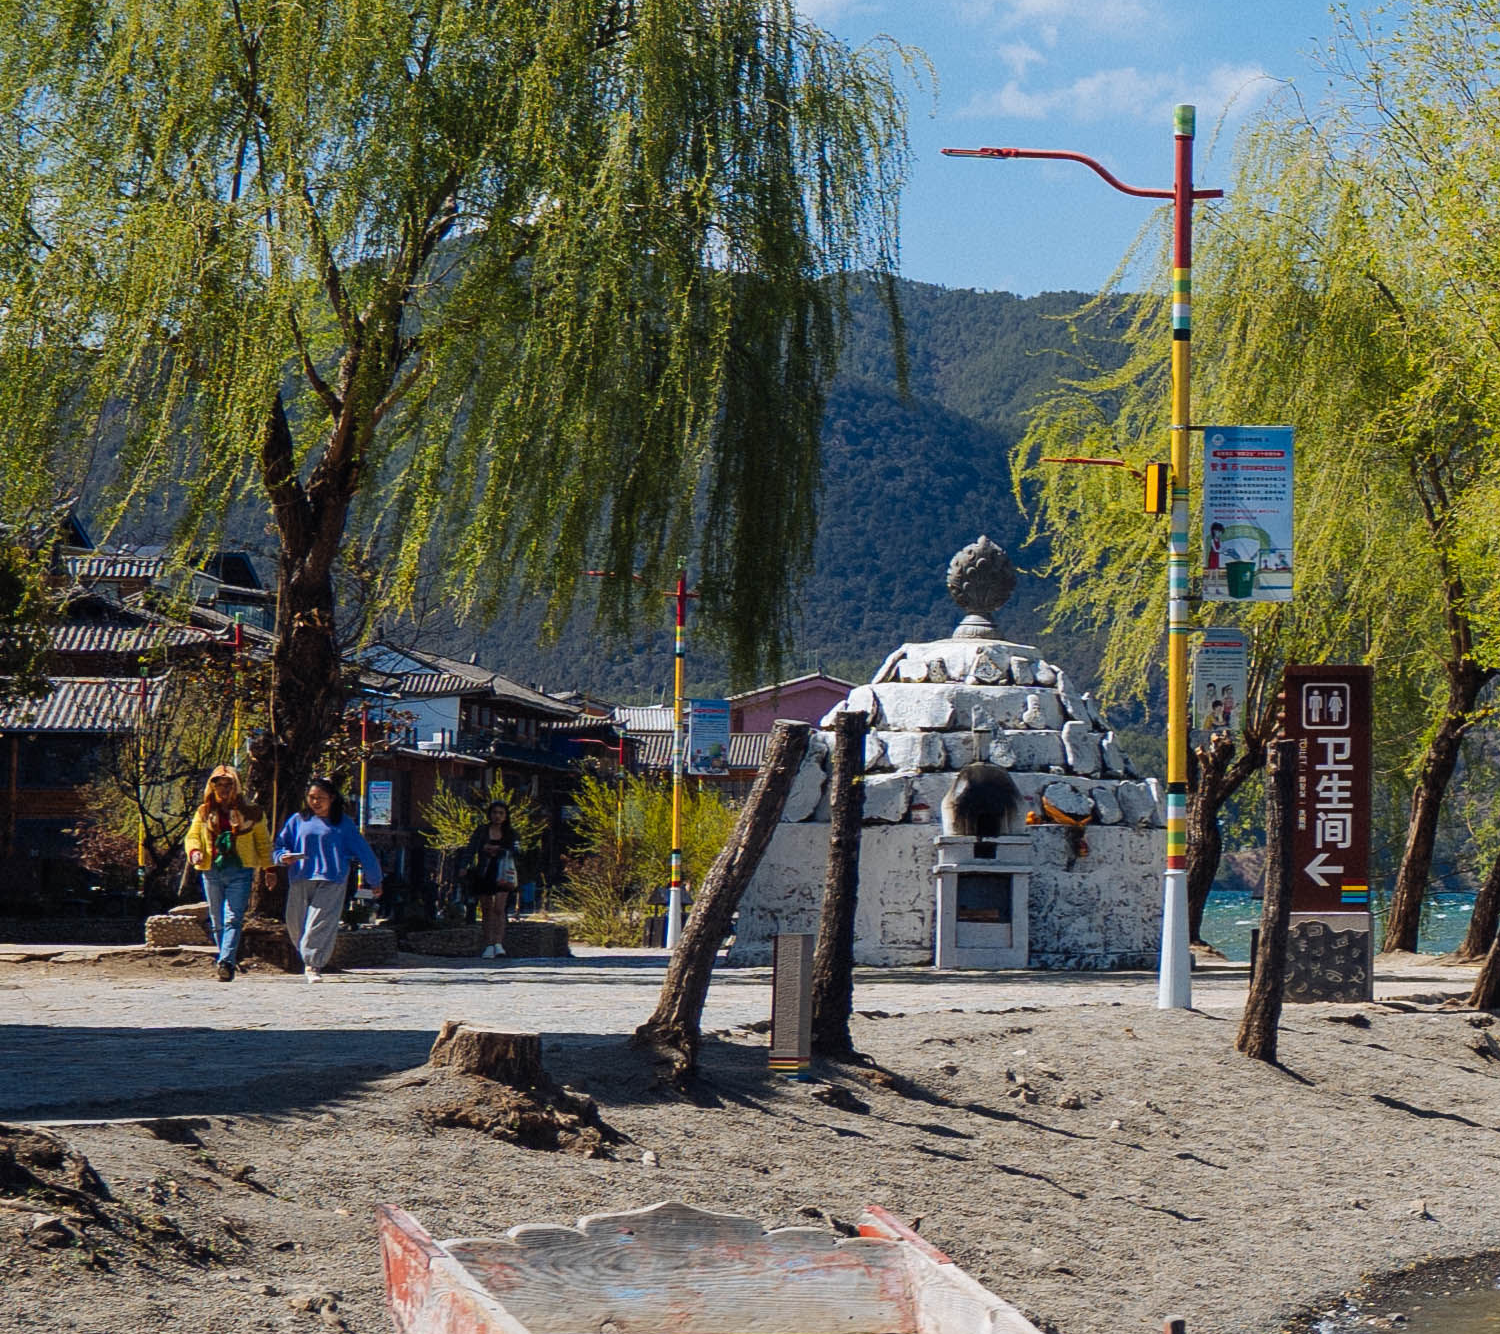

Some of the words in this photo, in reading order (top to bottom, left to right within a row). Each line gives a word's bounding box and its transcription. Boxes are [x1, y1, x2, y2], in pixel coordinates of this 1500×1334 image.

[1298, 738, 1308, 764] TOILET
[1315, 737, 1353, 849] 卫生间
